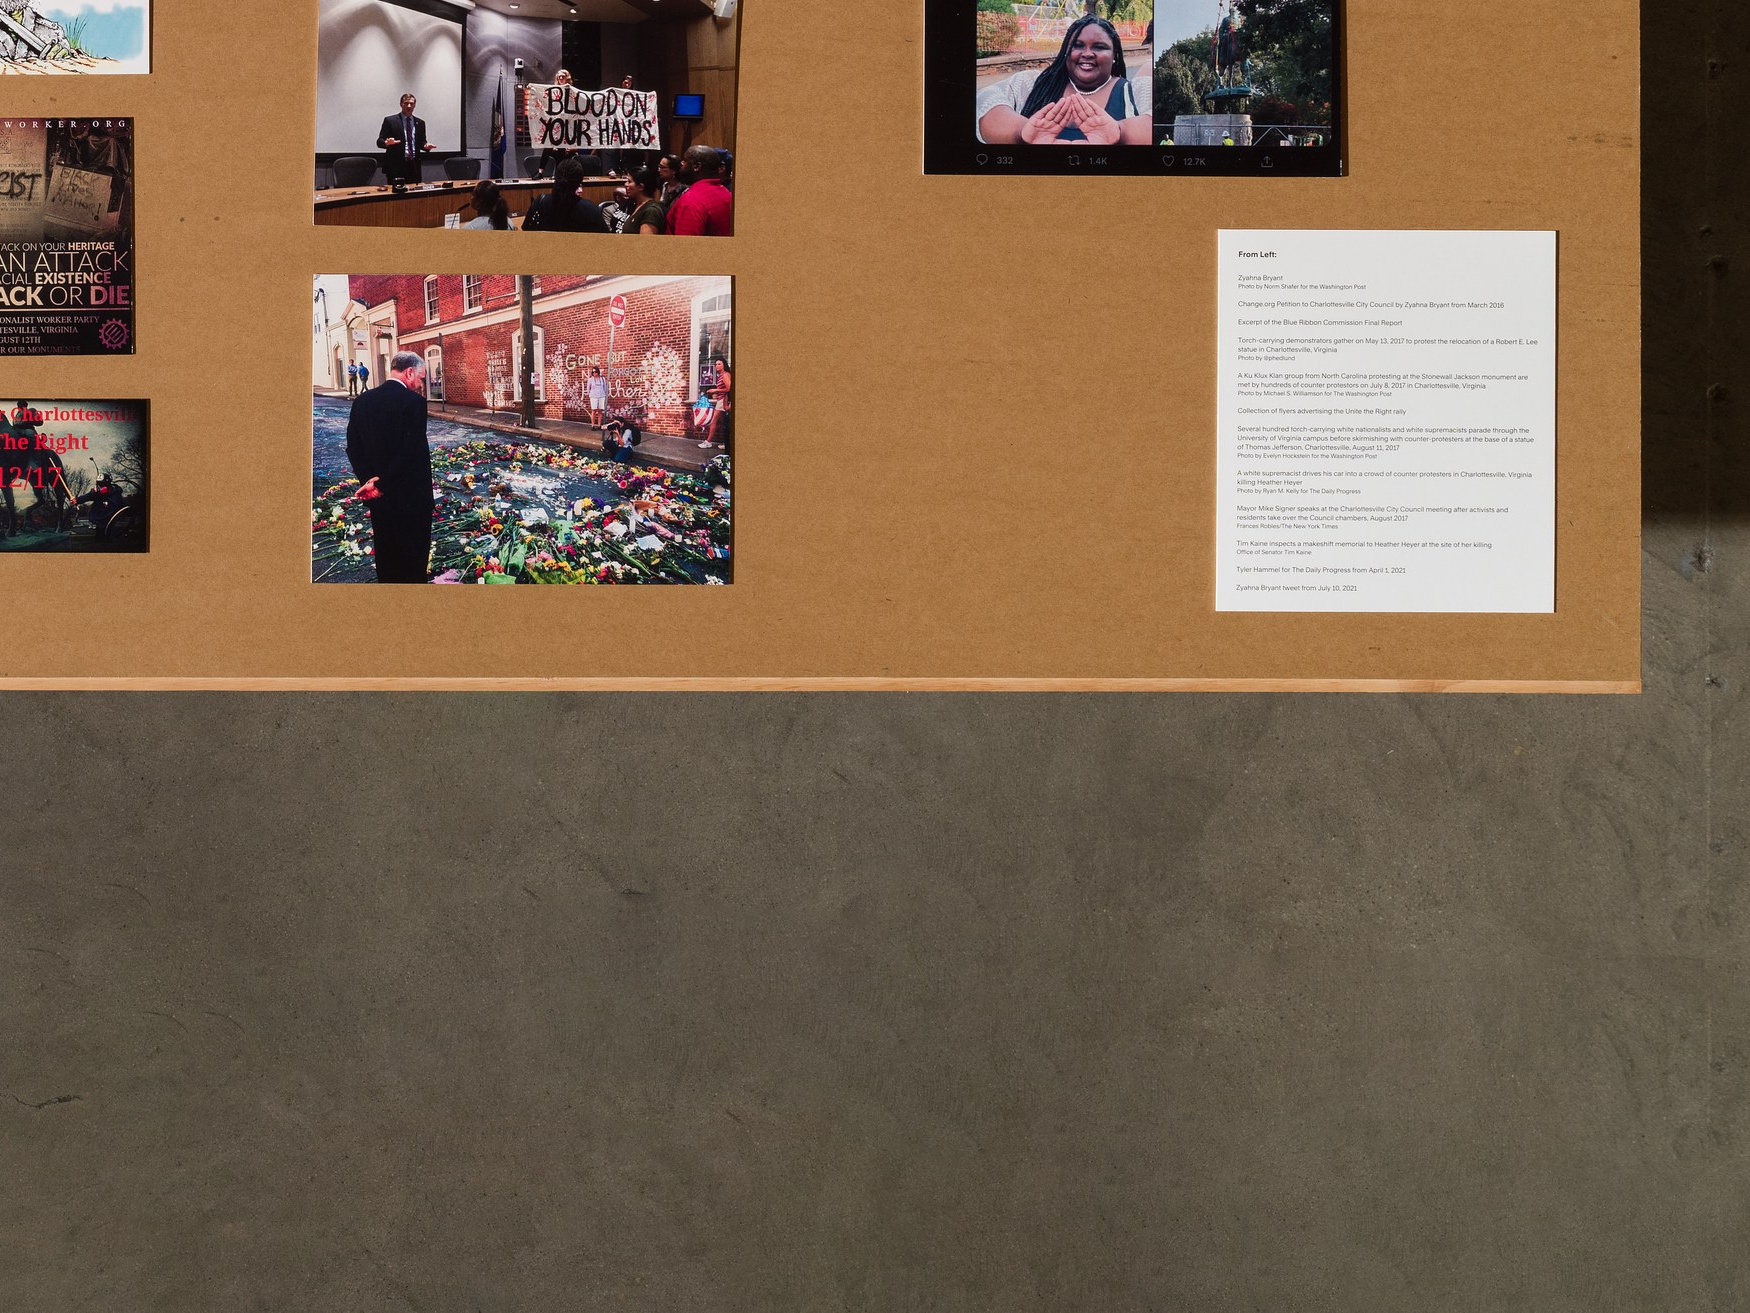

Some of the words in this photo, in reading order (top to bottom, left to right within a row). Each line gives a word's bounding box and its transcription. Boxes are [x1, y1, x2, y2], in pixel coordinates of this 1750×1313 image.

[544, 87, 618, 117] BLOOD
[621, 92, 648, 119] ON
[539, 117, 592, 146] YOUR
[598, 118, 652, 146] HANDS
[996, 156, 1013, 165] 332
[1089, 156, 1107, 166] 1.4K
[1183, 157, 1206, 167] 12.7K
[22, 242, 37, 252] ON
[38, 242, 66, 251] YOUR
[68, 242, 115, 251] HERITAGE
[1238, 250, 1258, 259] From
[1260, 250, 1277, 259] Left:
[33, 250, 129, 272] ATTACK
[35, 272, 112, 285] EXISTENCE
[1238, 273, 1262, 283] Zyahna
[1262, 273, 1283, 283] Bryant
[49, 286, 83, 306] OR
[90, 286, 129, 305] DIE
[36, 315, 72, 325] WORKER
[73, 315, 100, 325] PARTY
[1238, 318, 1263, 327] Excerpt
[1283, 318, 1298, 327] Blue
[1299, 318, 1322, 327] Ribbon
[1323, 318, 1363, 327] Commission
[1364, 318, 1380, 327] Final
[1381, 318, 1403, 328] Report
[40, 325, 78, 334] VIRGINIA
[22, 335, 41, 344] 12TH
[7, 345, 25, 355] OUR
[565, 353, 600, 371] GONE
[34, 432, 89, 455] Right
